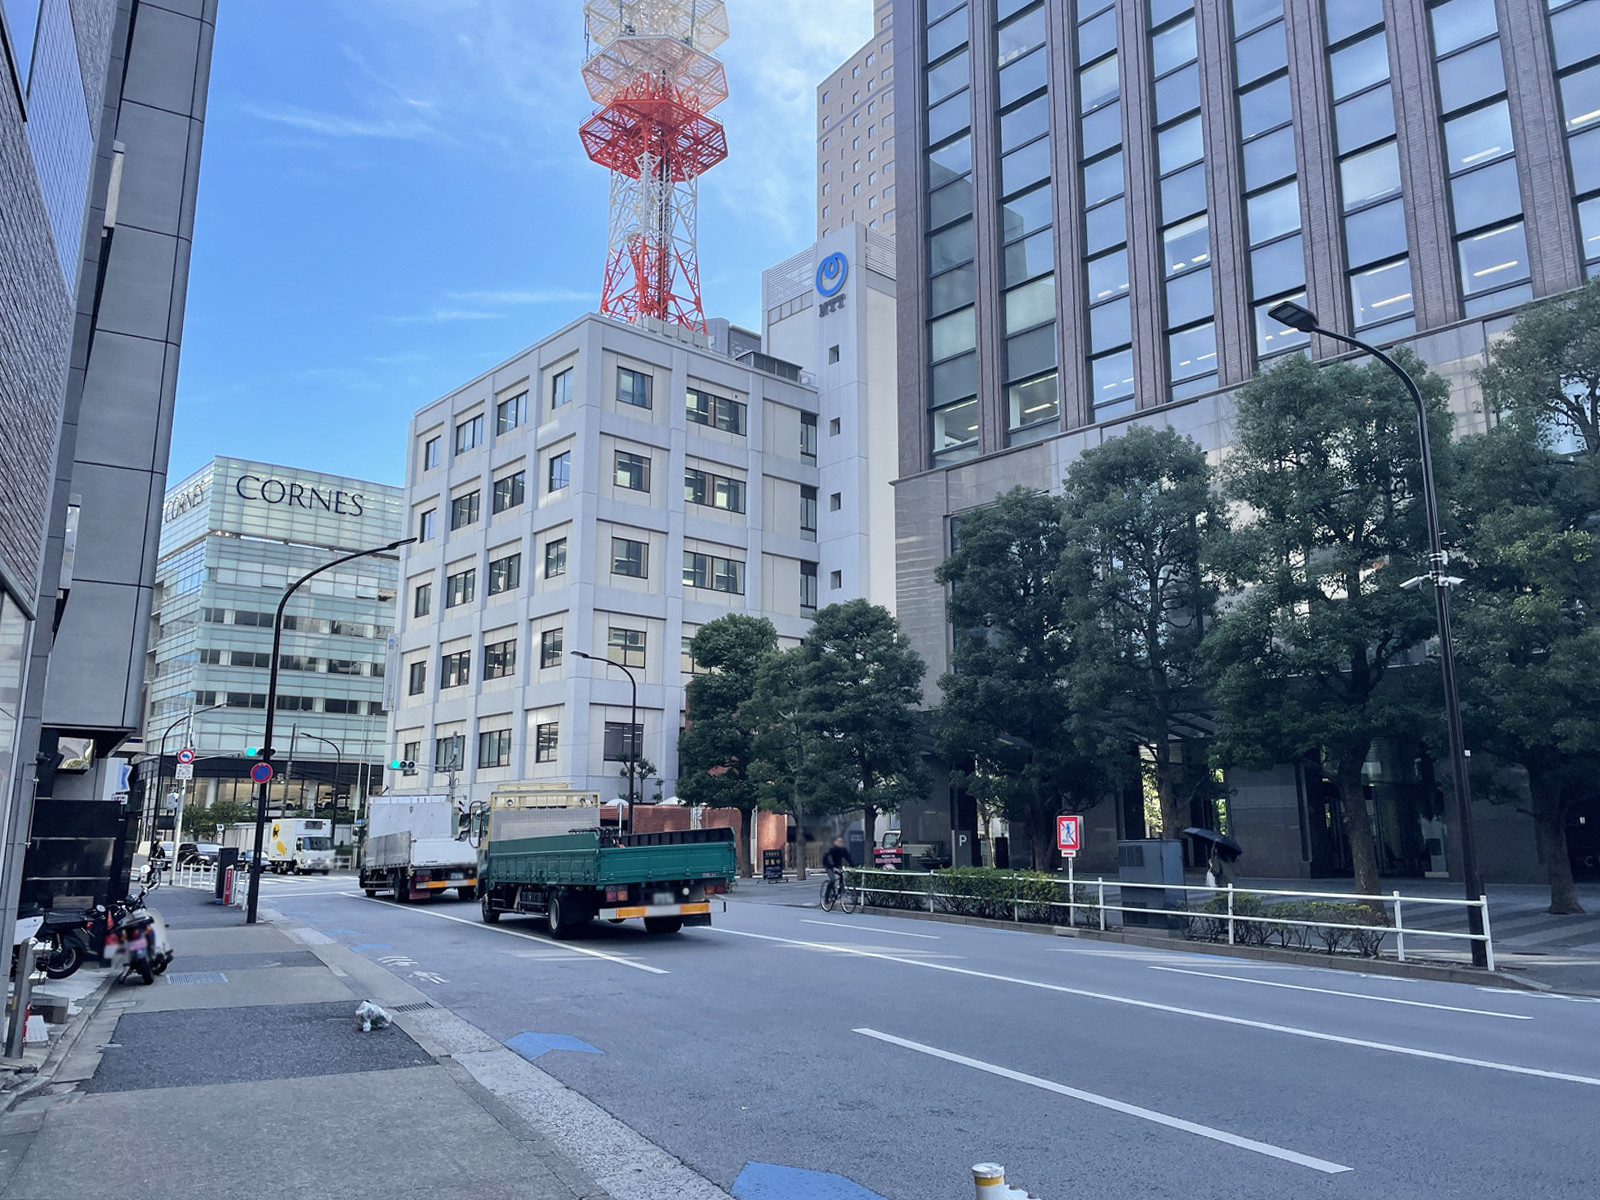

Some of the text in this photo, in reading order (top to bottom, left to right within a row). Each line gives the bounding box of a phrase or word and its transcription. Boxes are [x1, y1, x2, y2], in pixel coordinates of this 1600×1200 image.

[819, 293, 846, 317] NTT
[165, 480, 205, 523] CORNES
[236, 475, 364, 516] CORNES
[959, 834, 967, 846] P
